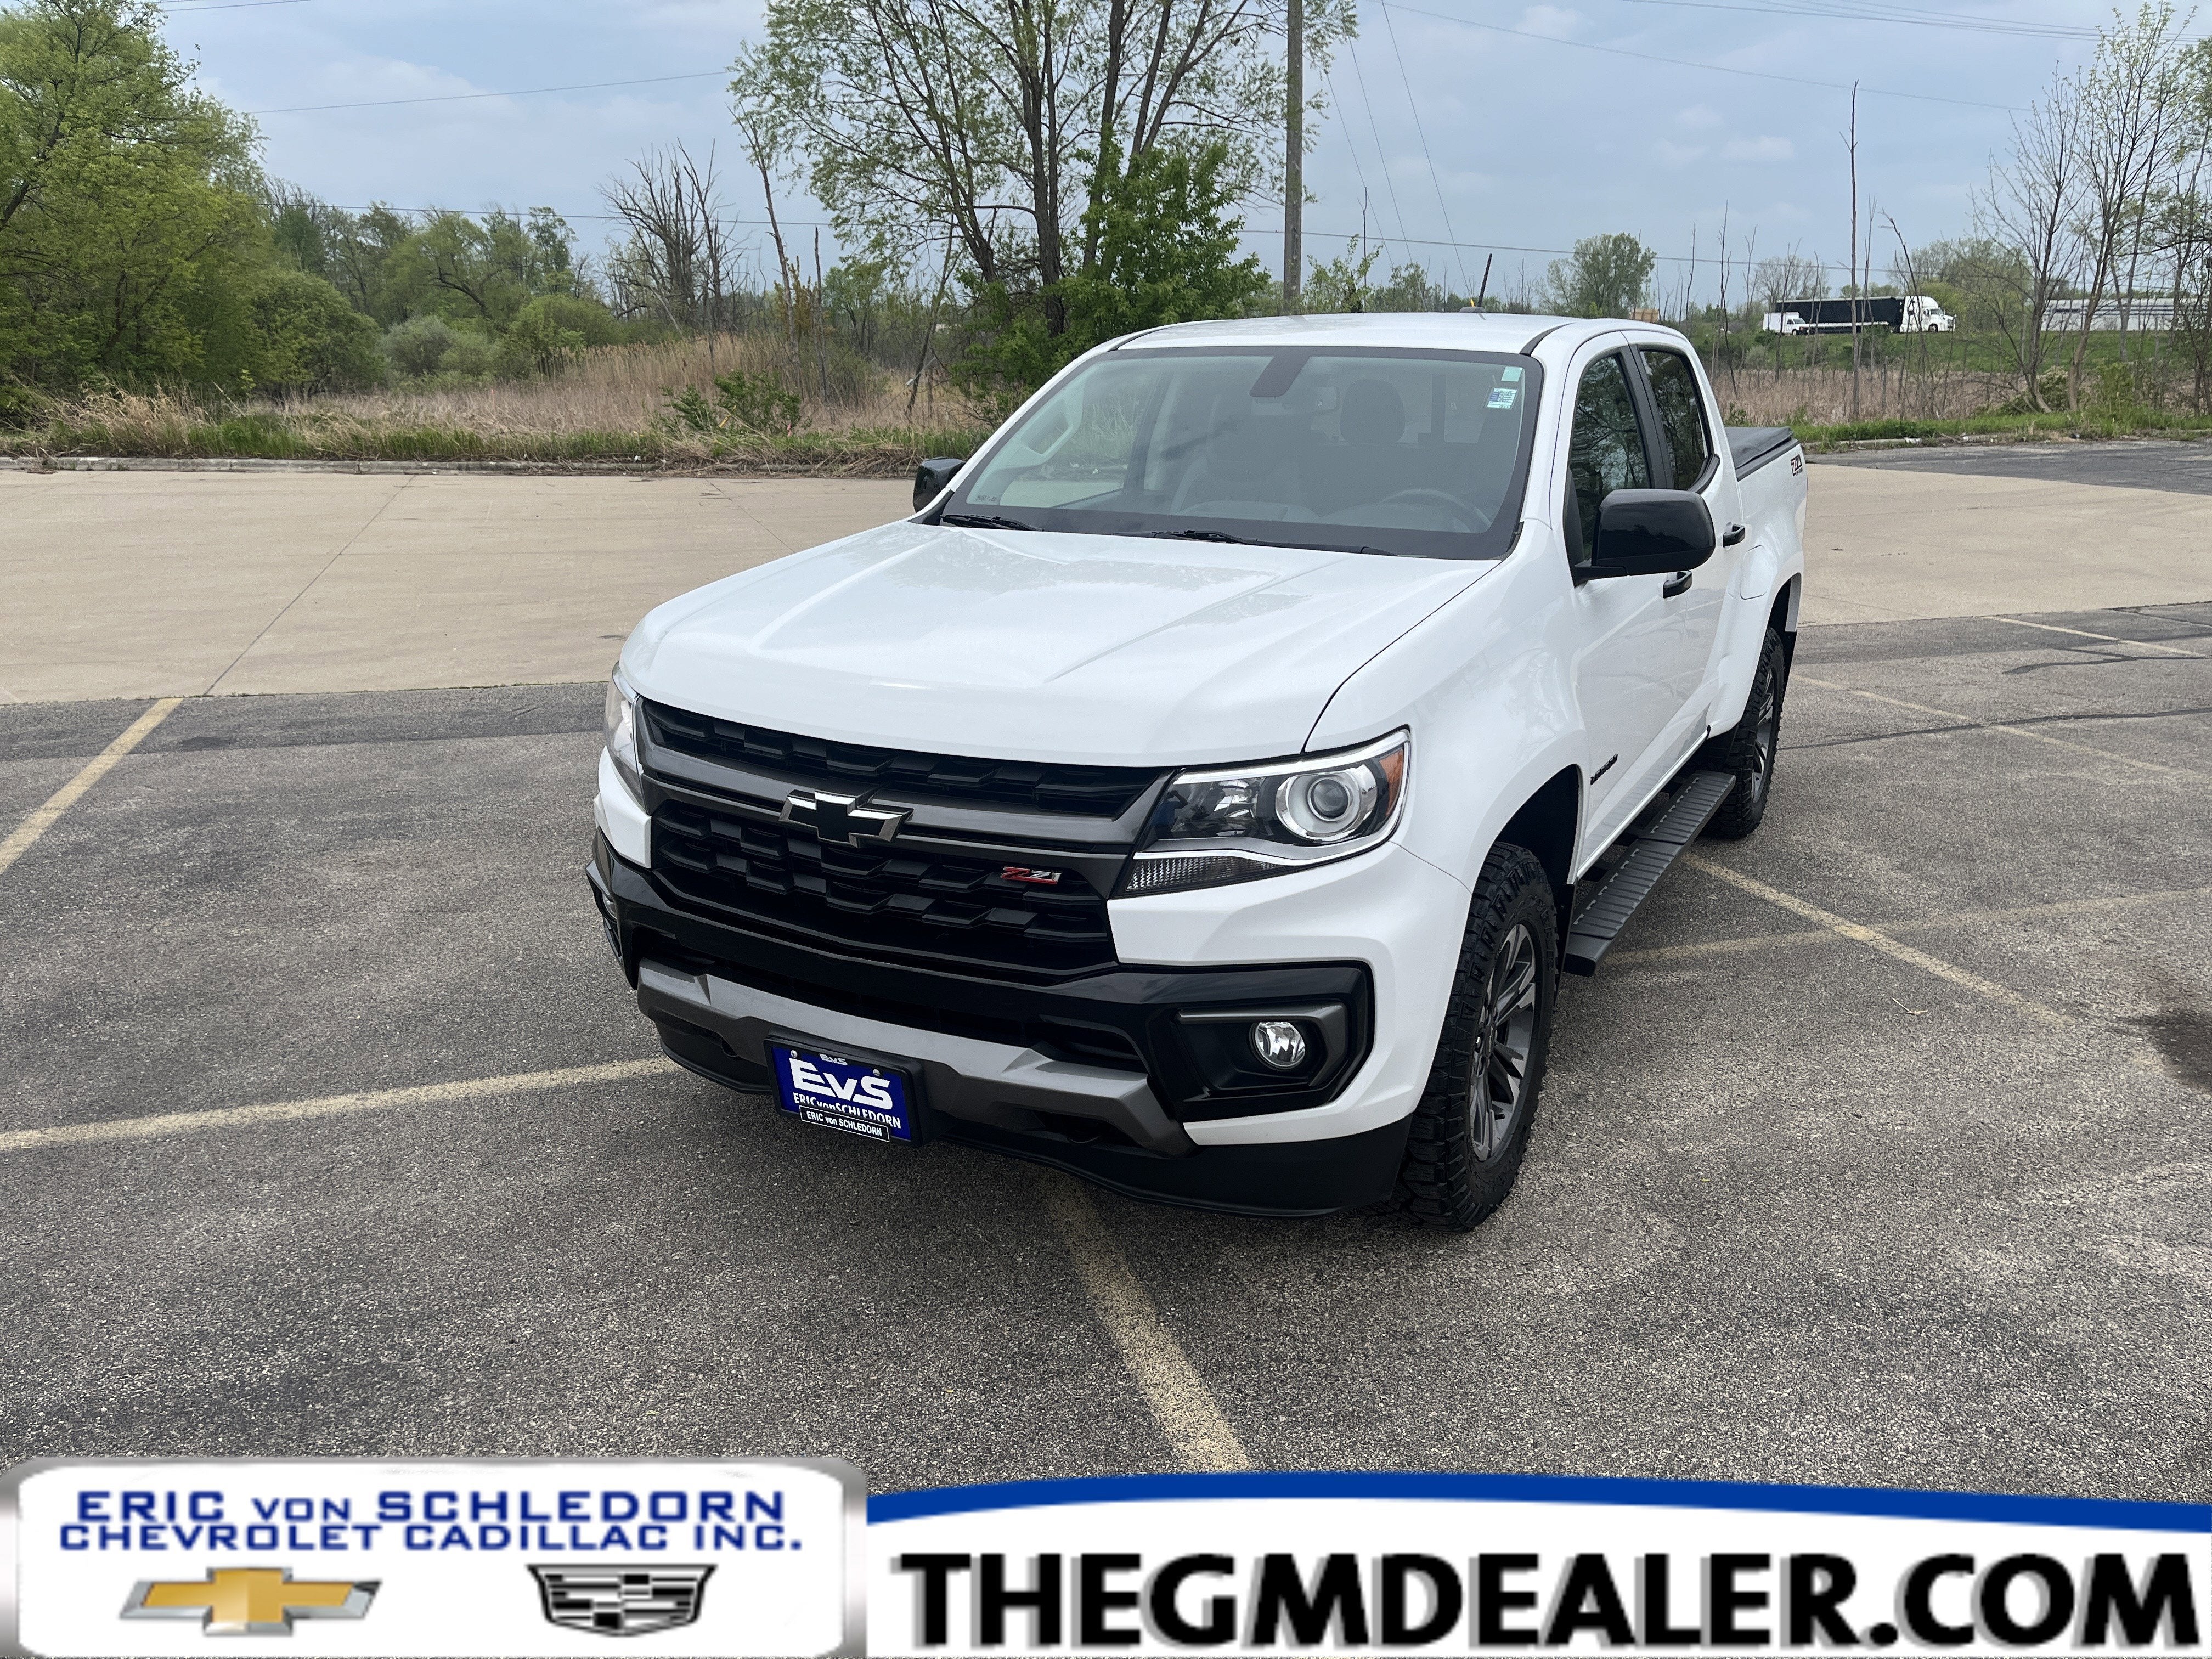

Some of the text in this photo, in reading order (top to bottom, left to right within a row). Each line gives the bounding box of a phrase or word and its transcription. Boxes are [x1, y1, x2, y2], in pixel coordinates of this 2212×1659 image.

[1000, 866, 1062, 885] Z71
[806, 1110, 882, 1137] ERIC von SCHLEDORN
